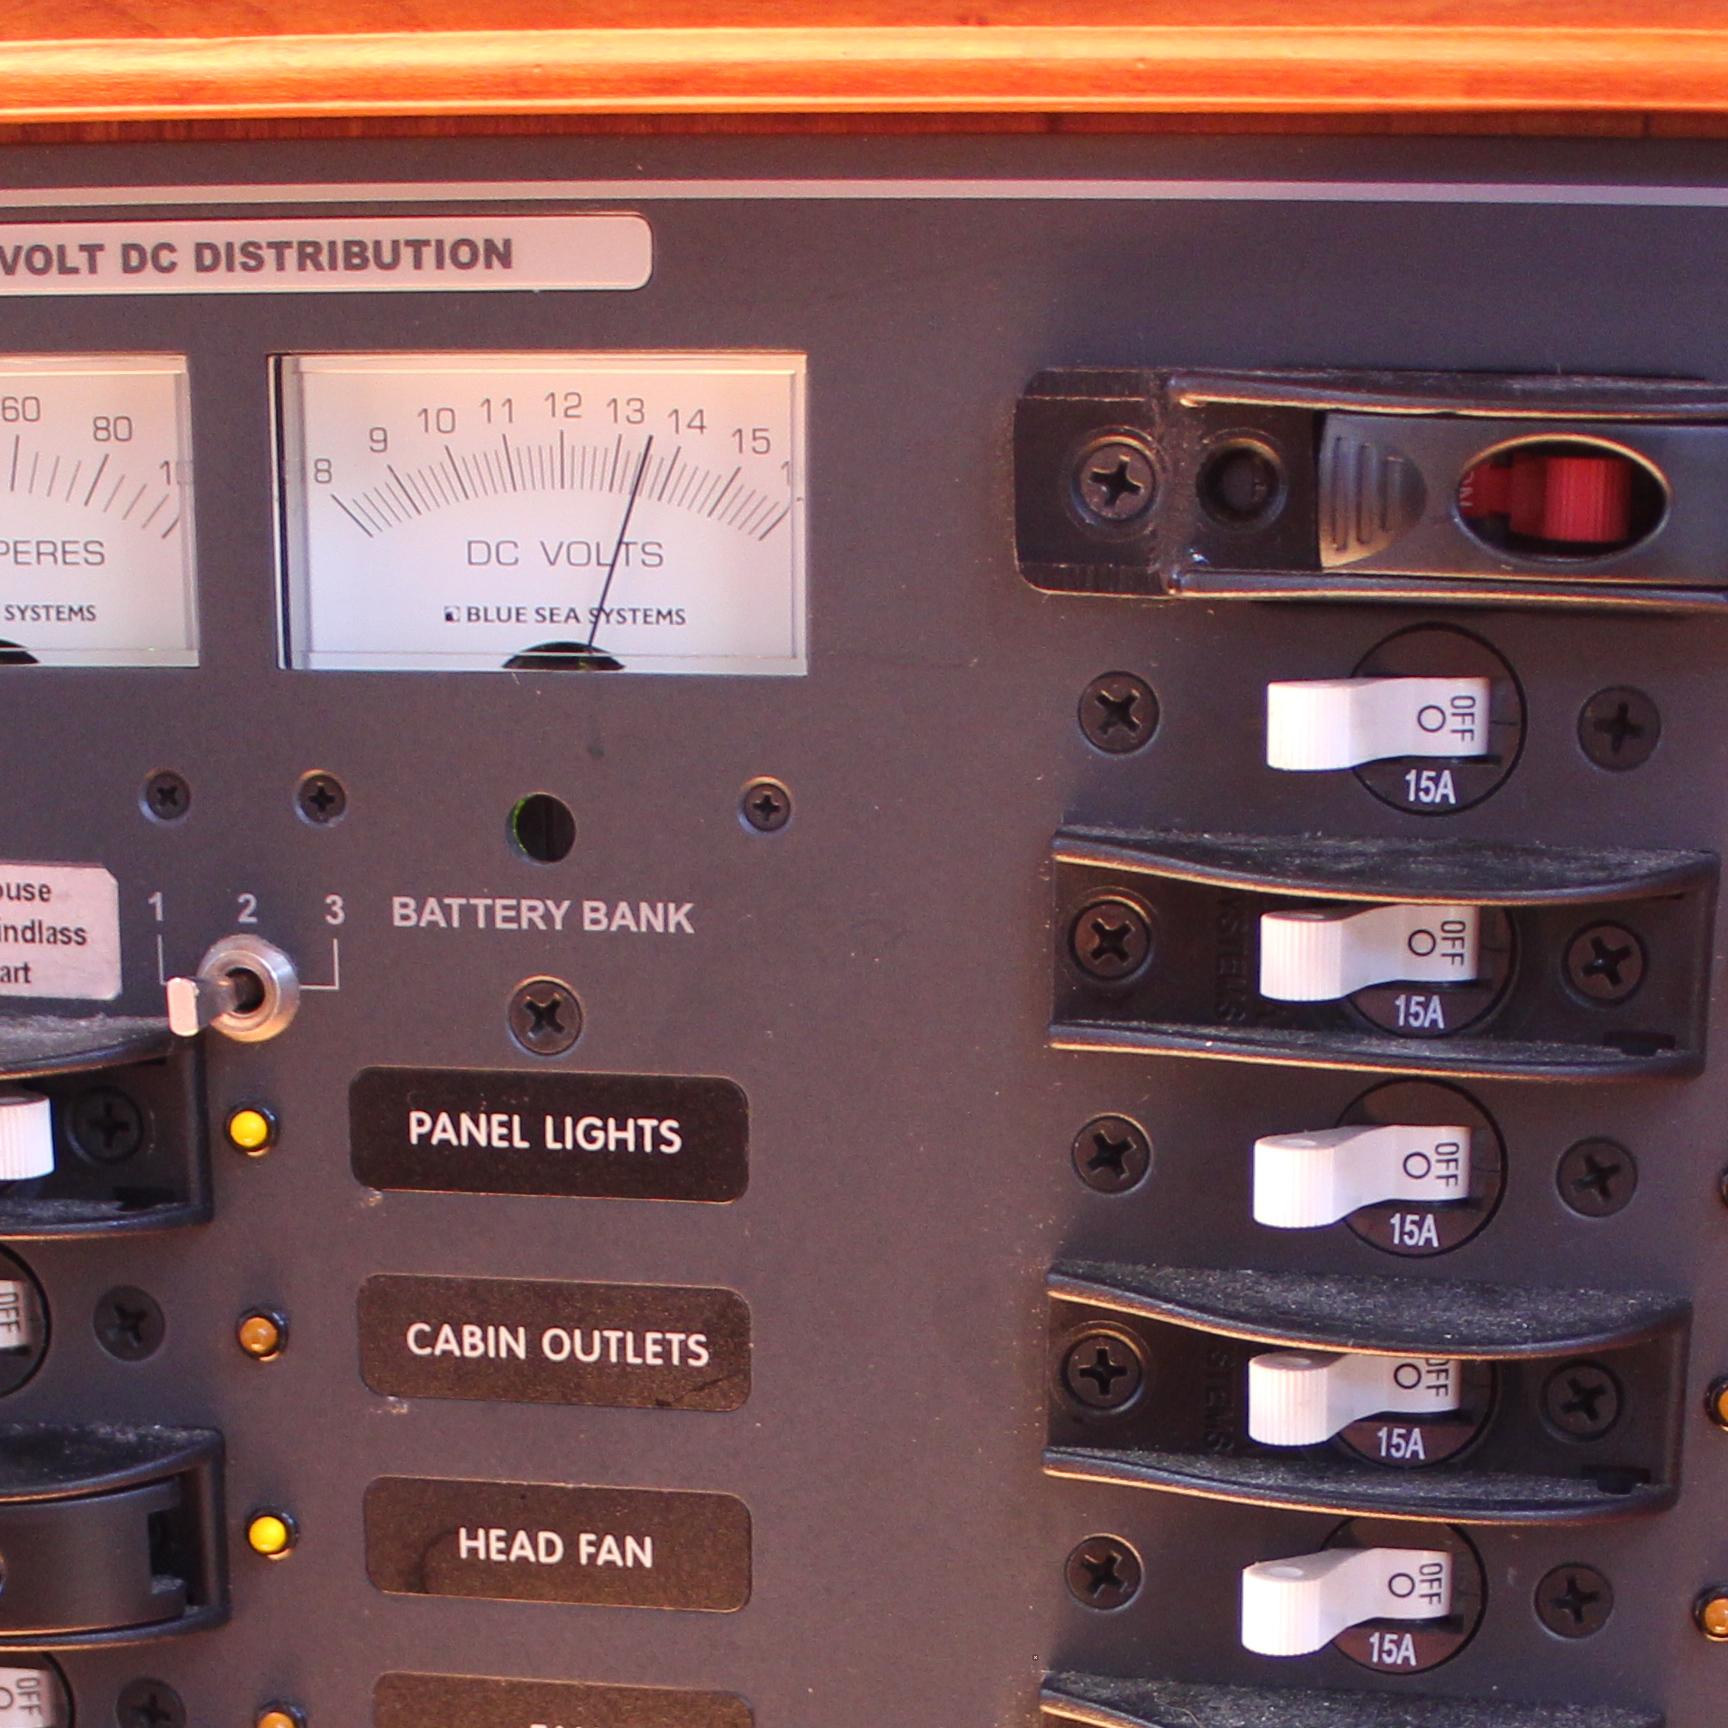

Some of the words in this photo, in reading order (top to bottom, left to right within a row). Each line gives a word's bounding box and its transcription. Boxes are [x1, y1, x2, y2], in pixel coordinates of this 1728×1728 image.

[121, 241, 178, 275] DC
[194, 237, 513, 273] DISTRIBUTION
[1, 395, 41, 423] 60
[92, 415, 133, 443] 80
[313, 457, 333, 485] 8
[368, 426, 388, 454] 9
[417, 407, 456, 435] 10
[480, 397, 513, 424] 11
[544, 391, 582, 419] 12
[606, 397, 645, 425] 13
[668, 408, 707, 435] 14
[731, 427, 771, 455] 15
[467, 540, 519, 567] DC
[540, 541, 663, 568] VOLTS
[4, 604, 97, 622] SYSTEMS
[466, 606, 526, 624] BLUE
[534, 606, 581, 624] SEA
[589, 608, 686, 626] SYSTEMS
[1450, 695, 1477, 742] OFF
[1405, 769, 1456, 804] 15A
[148, 891, 163, 922] 1
[237, 893, 258, 923] 2
[325, 894, 345, 925] 3
[392, 896, 571, 931] BATTERY
[582, 900, 695, 934] BANK
[1440, 920, 1467, 966] OFF
[1394, 994, 1445, 1029] 15A
[409, 1110, 530, 1149] PANEL
[545, 1115, 682, 1154] LIGHTS
[1434, 1141, 1461, 1187] OFF
[1390, 1213, 1439, 1248] 15A
[406, 1322, 526, 1360] CABIN
[542, 1328, 710, 1367] OUTLETS
[1377, 1426, 1426, 1460] 15A
[459, 1527, 564, 1564] HEAD
[579, 1533, 653, 1569] FAN
[1419, 1562, 1444, 1605] OFF
[1369, 1632, 1417, 1667] 15A
[17, 1678, 41, 1716] OFF
